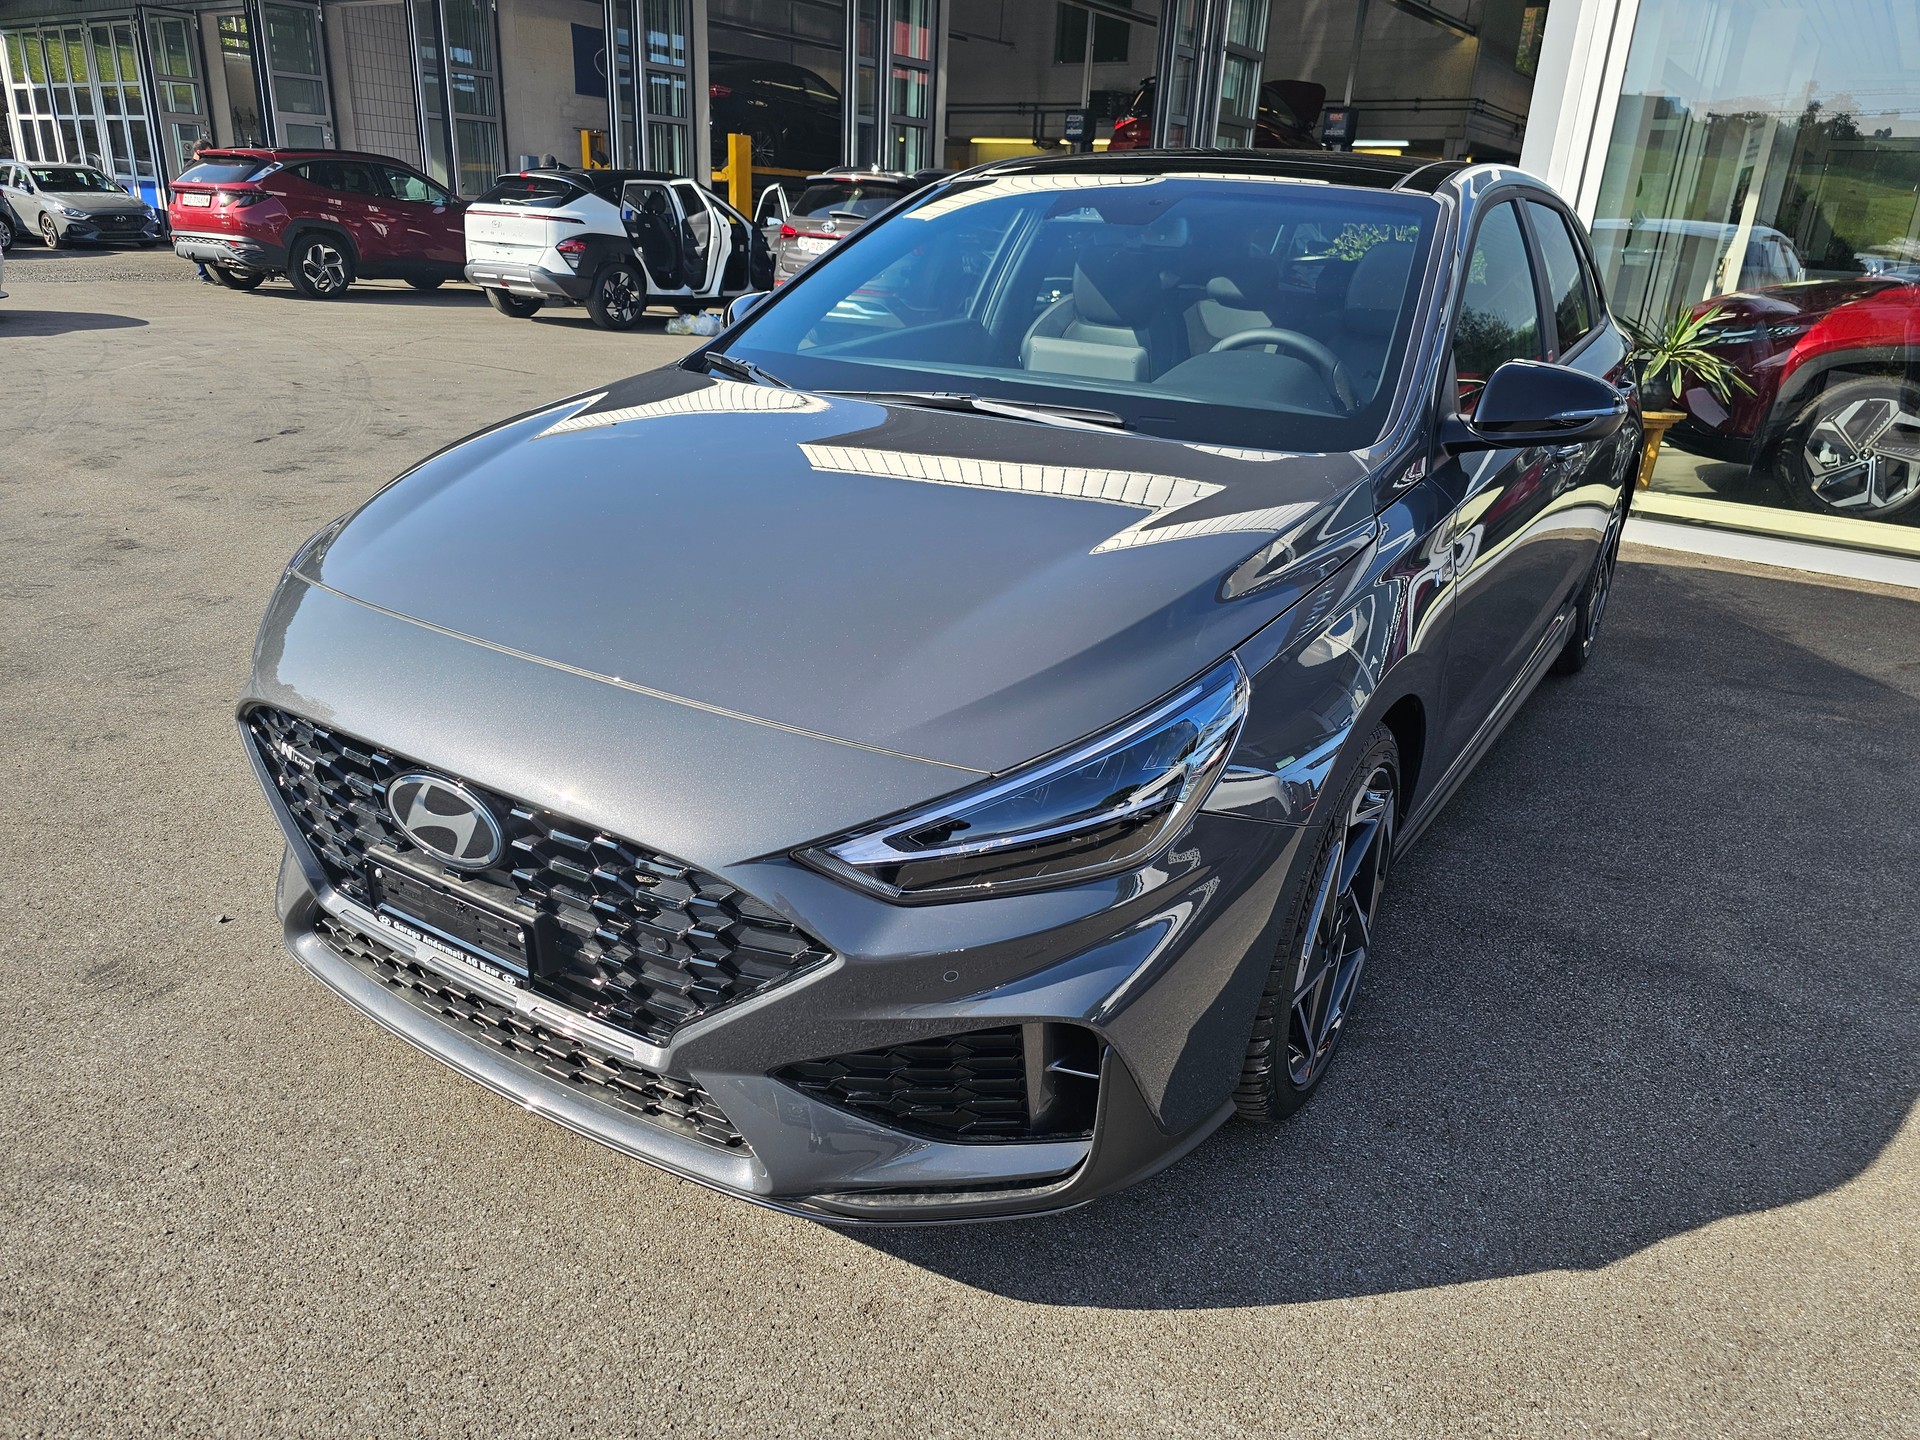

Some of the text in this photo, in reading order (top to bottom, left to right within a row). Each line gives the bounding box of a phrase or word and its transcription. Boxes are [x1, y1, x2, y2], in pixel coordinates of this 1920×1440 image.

[393, 921, 500, 978] Garage Andermatt AG Baar
